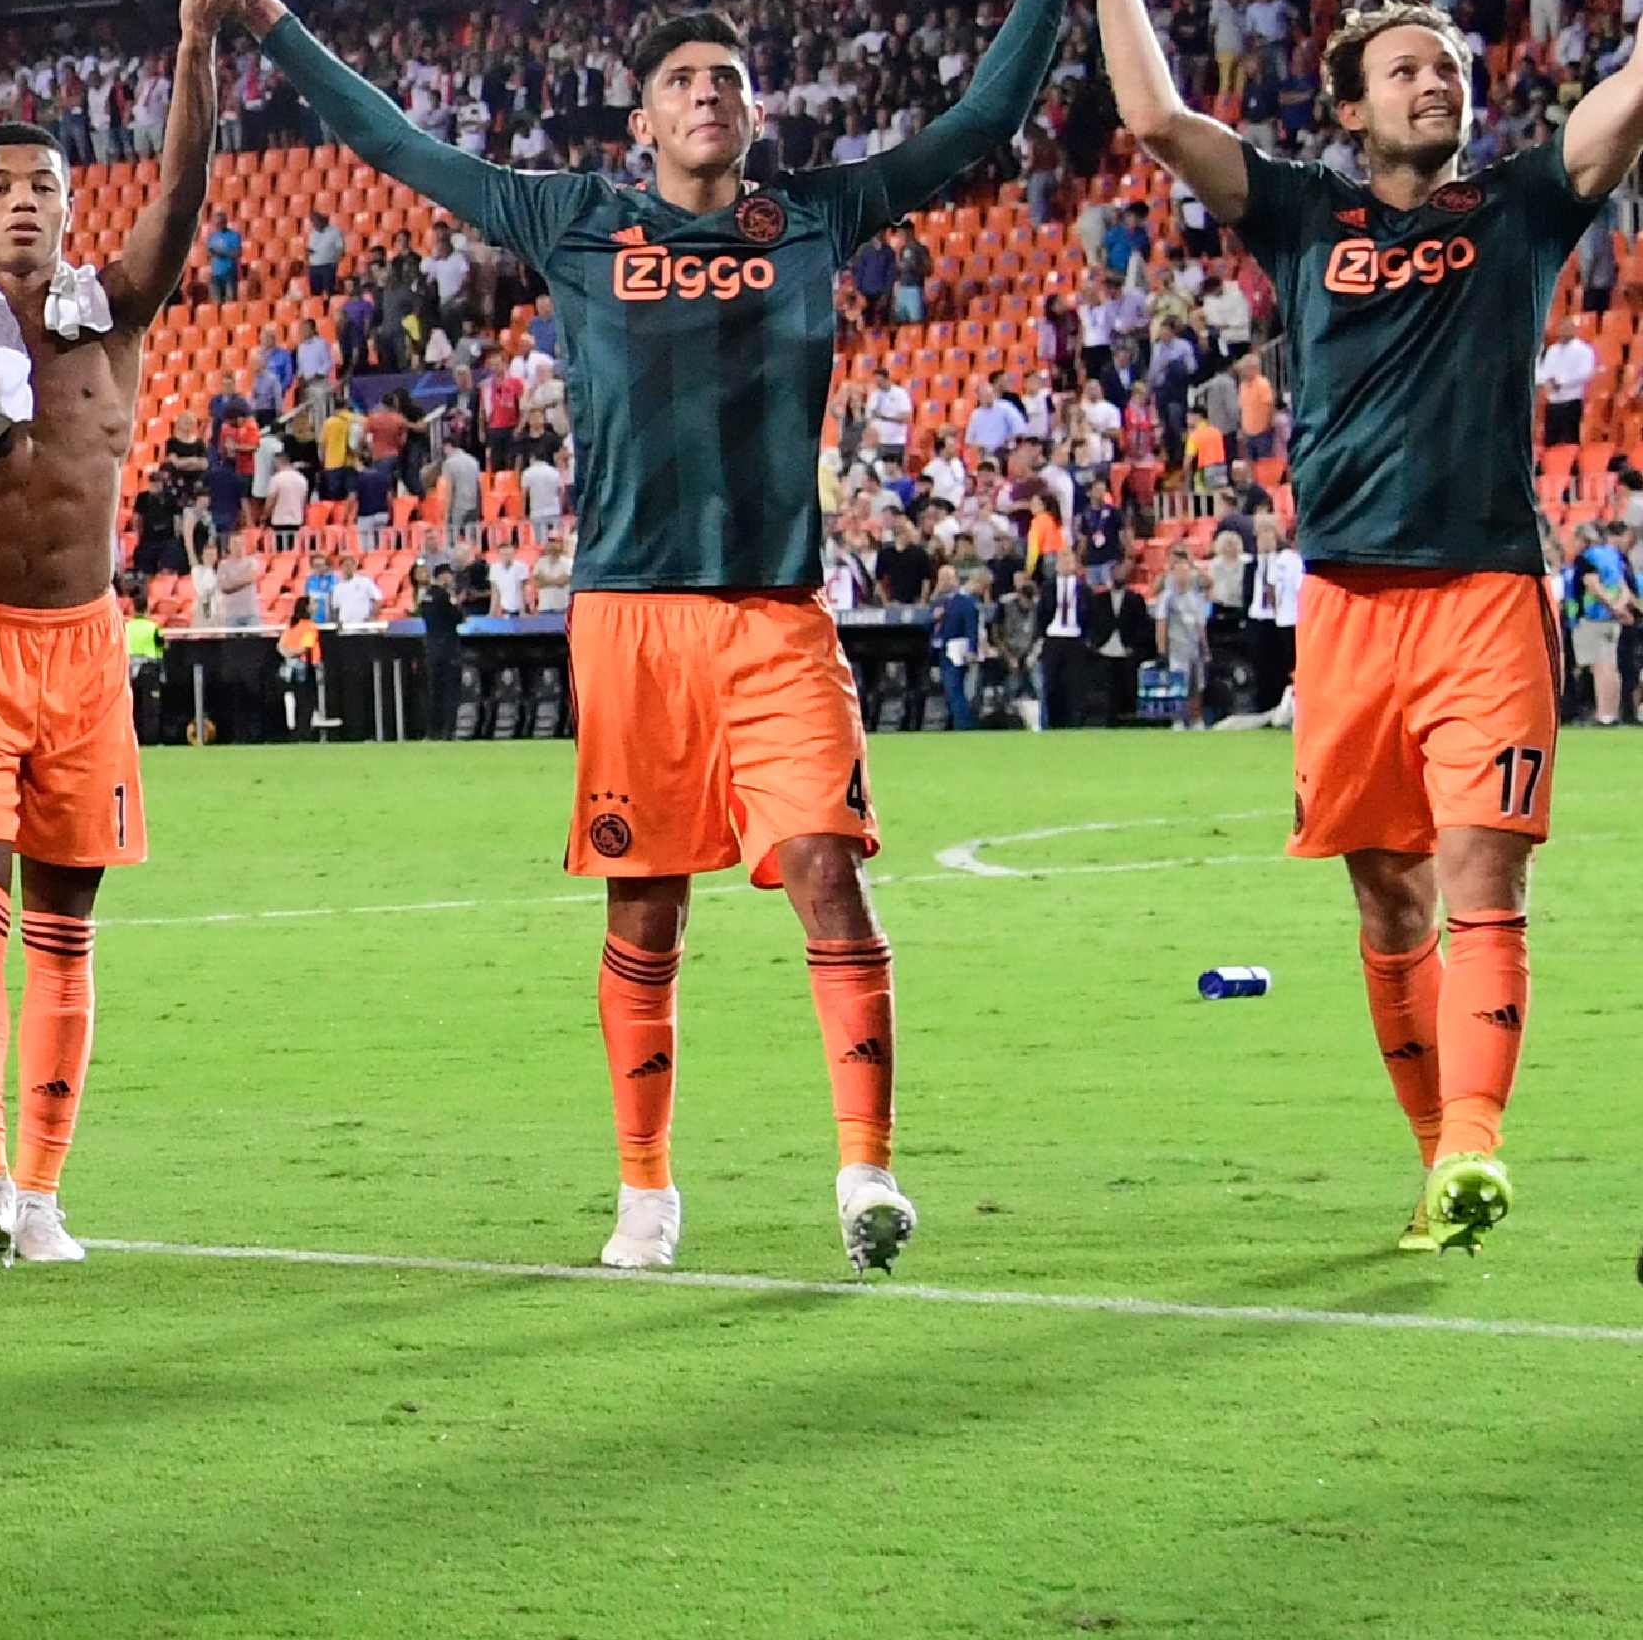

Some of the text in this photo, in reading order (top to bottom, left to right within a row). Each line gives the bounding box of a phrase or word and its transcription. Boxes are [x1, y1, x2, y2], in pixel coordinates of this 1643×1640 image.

[615, 246, 774, 300] Ziggo
[1324, 236, 1476, 294] Ziggo
[846, 758, 868, 821] 4
[1494, 745, 1546, 818] 17
